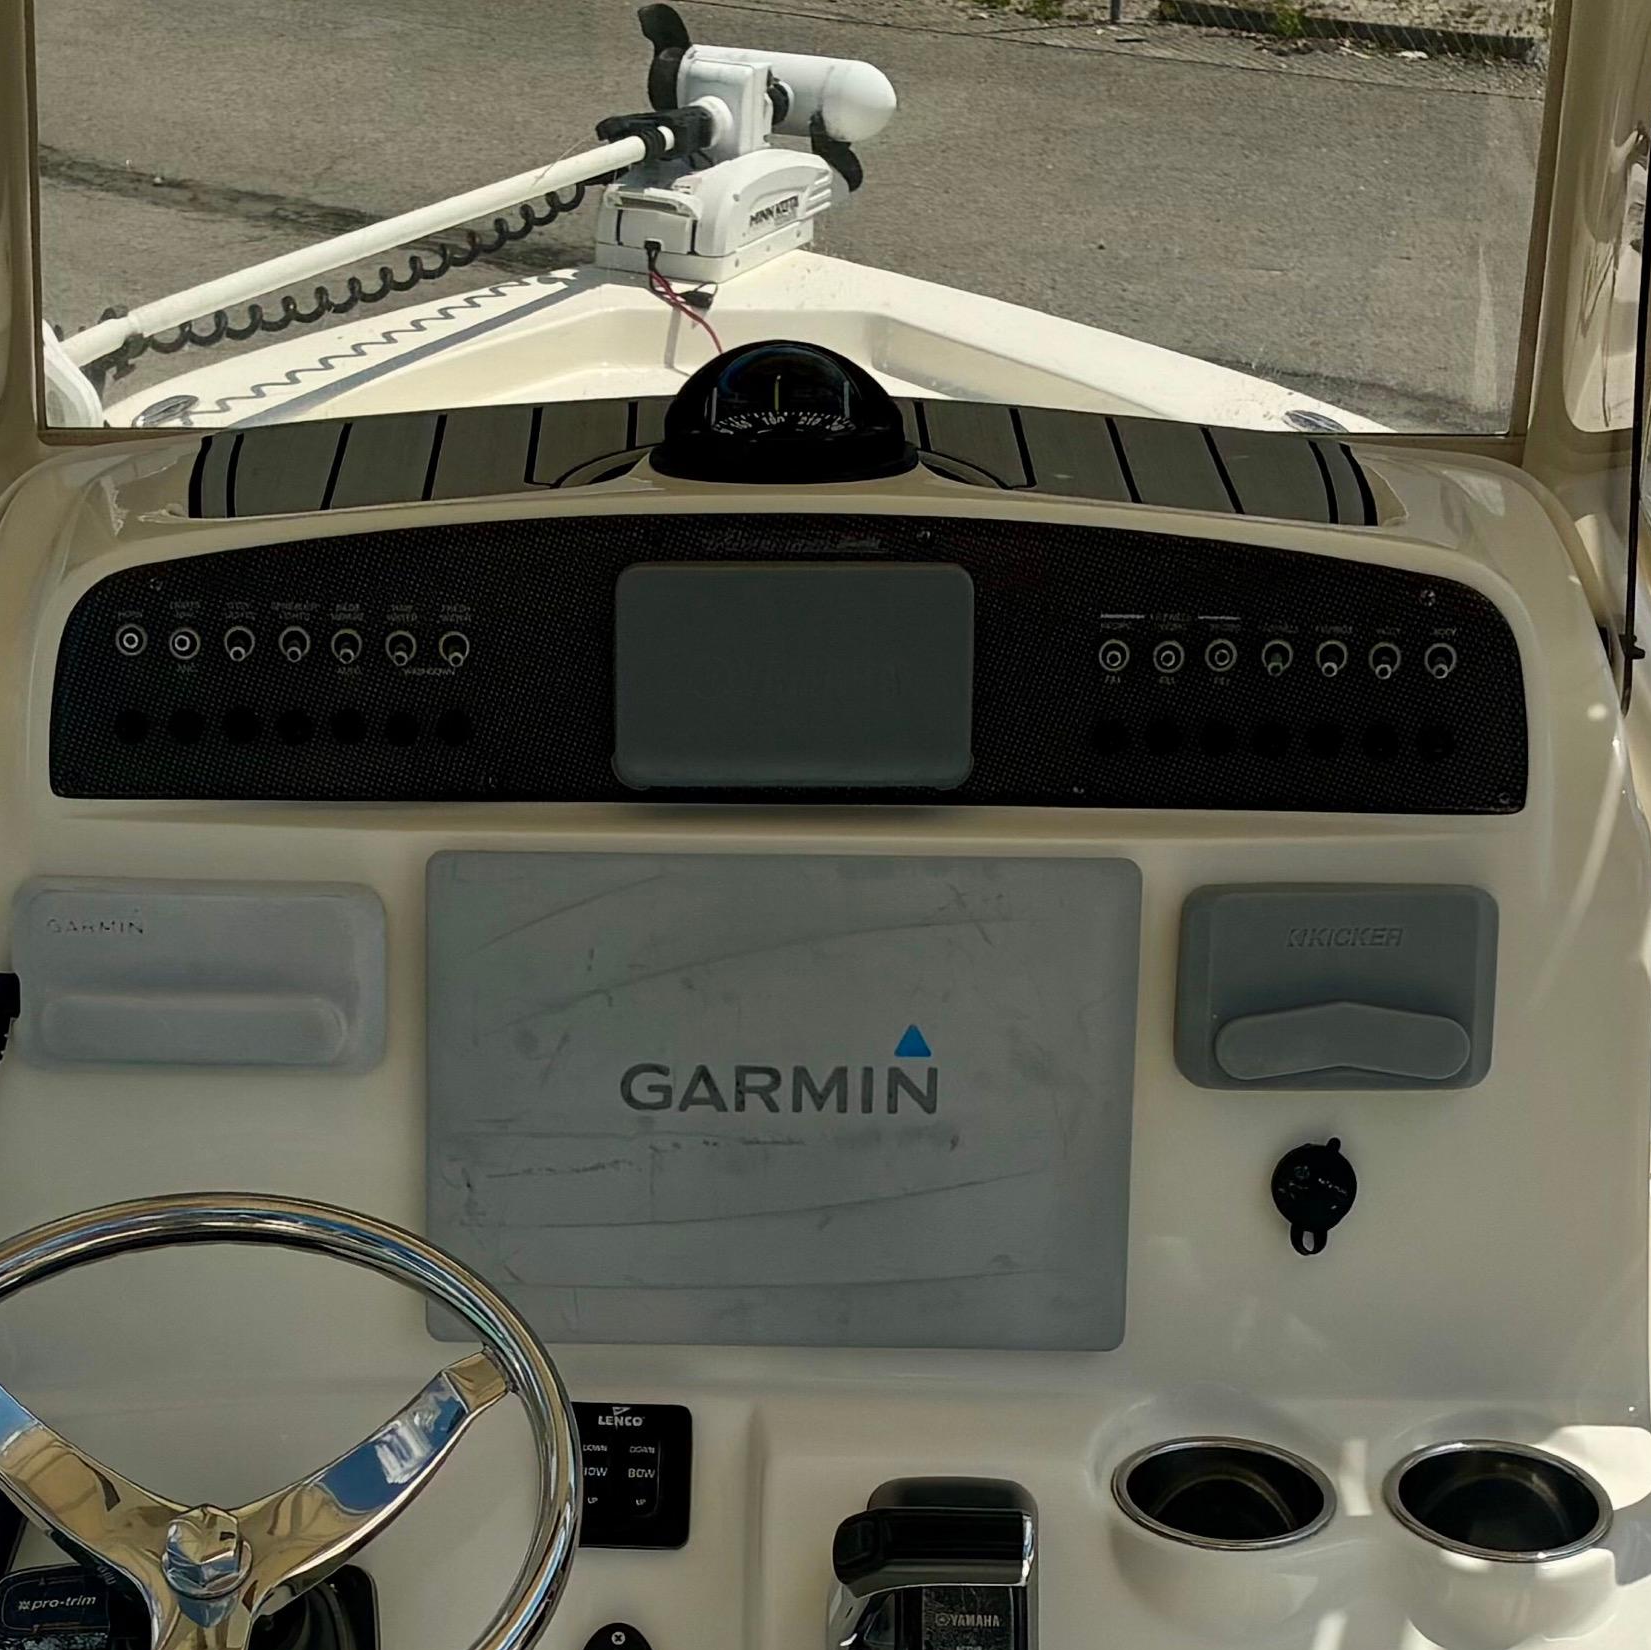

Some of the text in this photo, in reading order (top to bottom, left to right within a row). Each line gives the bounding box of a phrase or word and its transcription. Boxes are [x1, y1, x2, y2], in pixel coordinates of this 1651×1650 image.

[46, 918, 144, 934] GARMIN
[619, 1062, 938, 1115] GARMIN
[597, 1415, 644, 1430] LENCO
[627, 1467, 656, 1479] BOW
[30, 1594, 97, 1611] pro-trim
[949, 1613, 1001, 1628] YAMAHA
